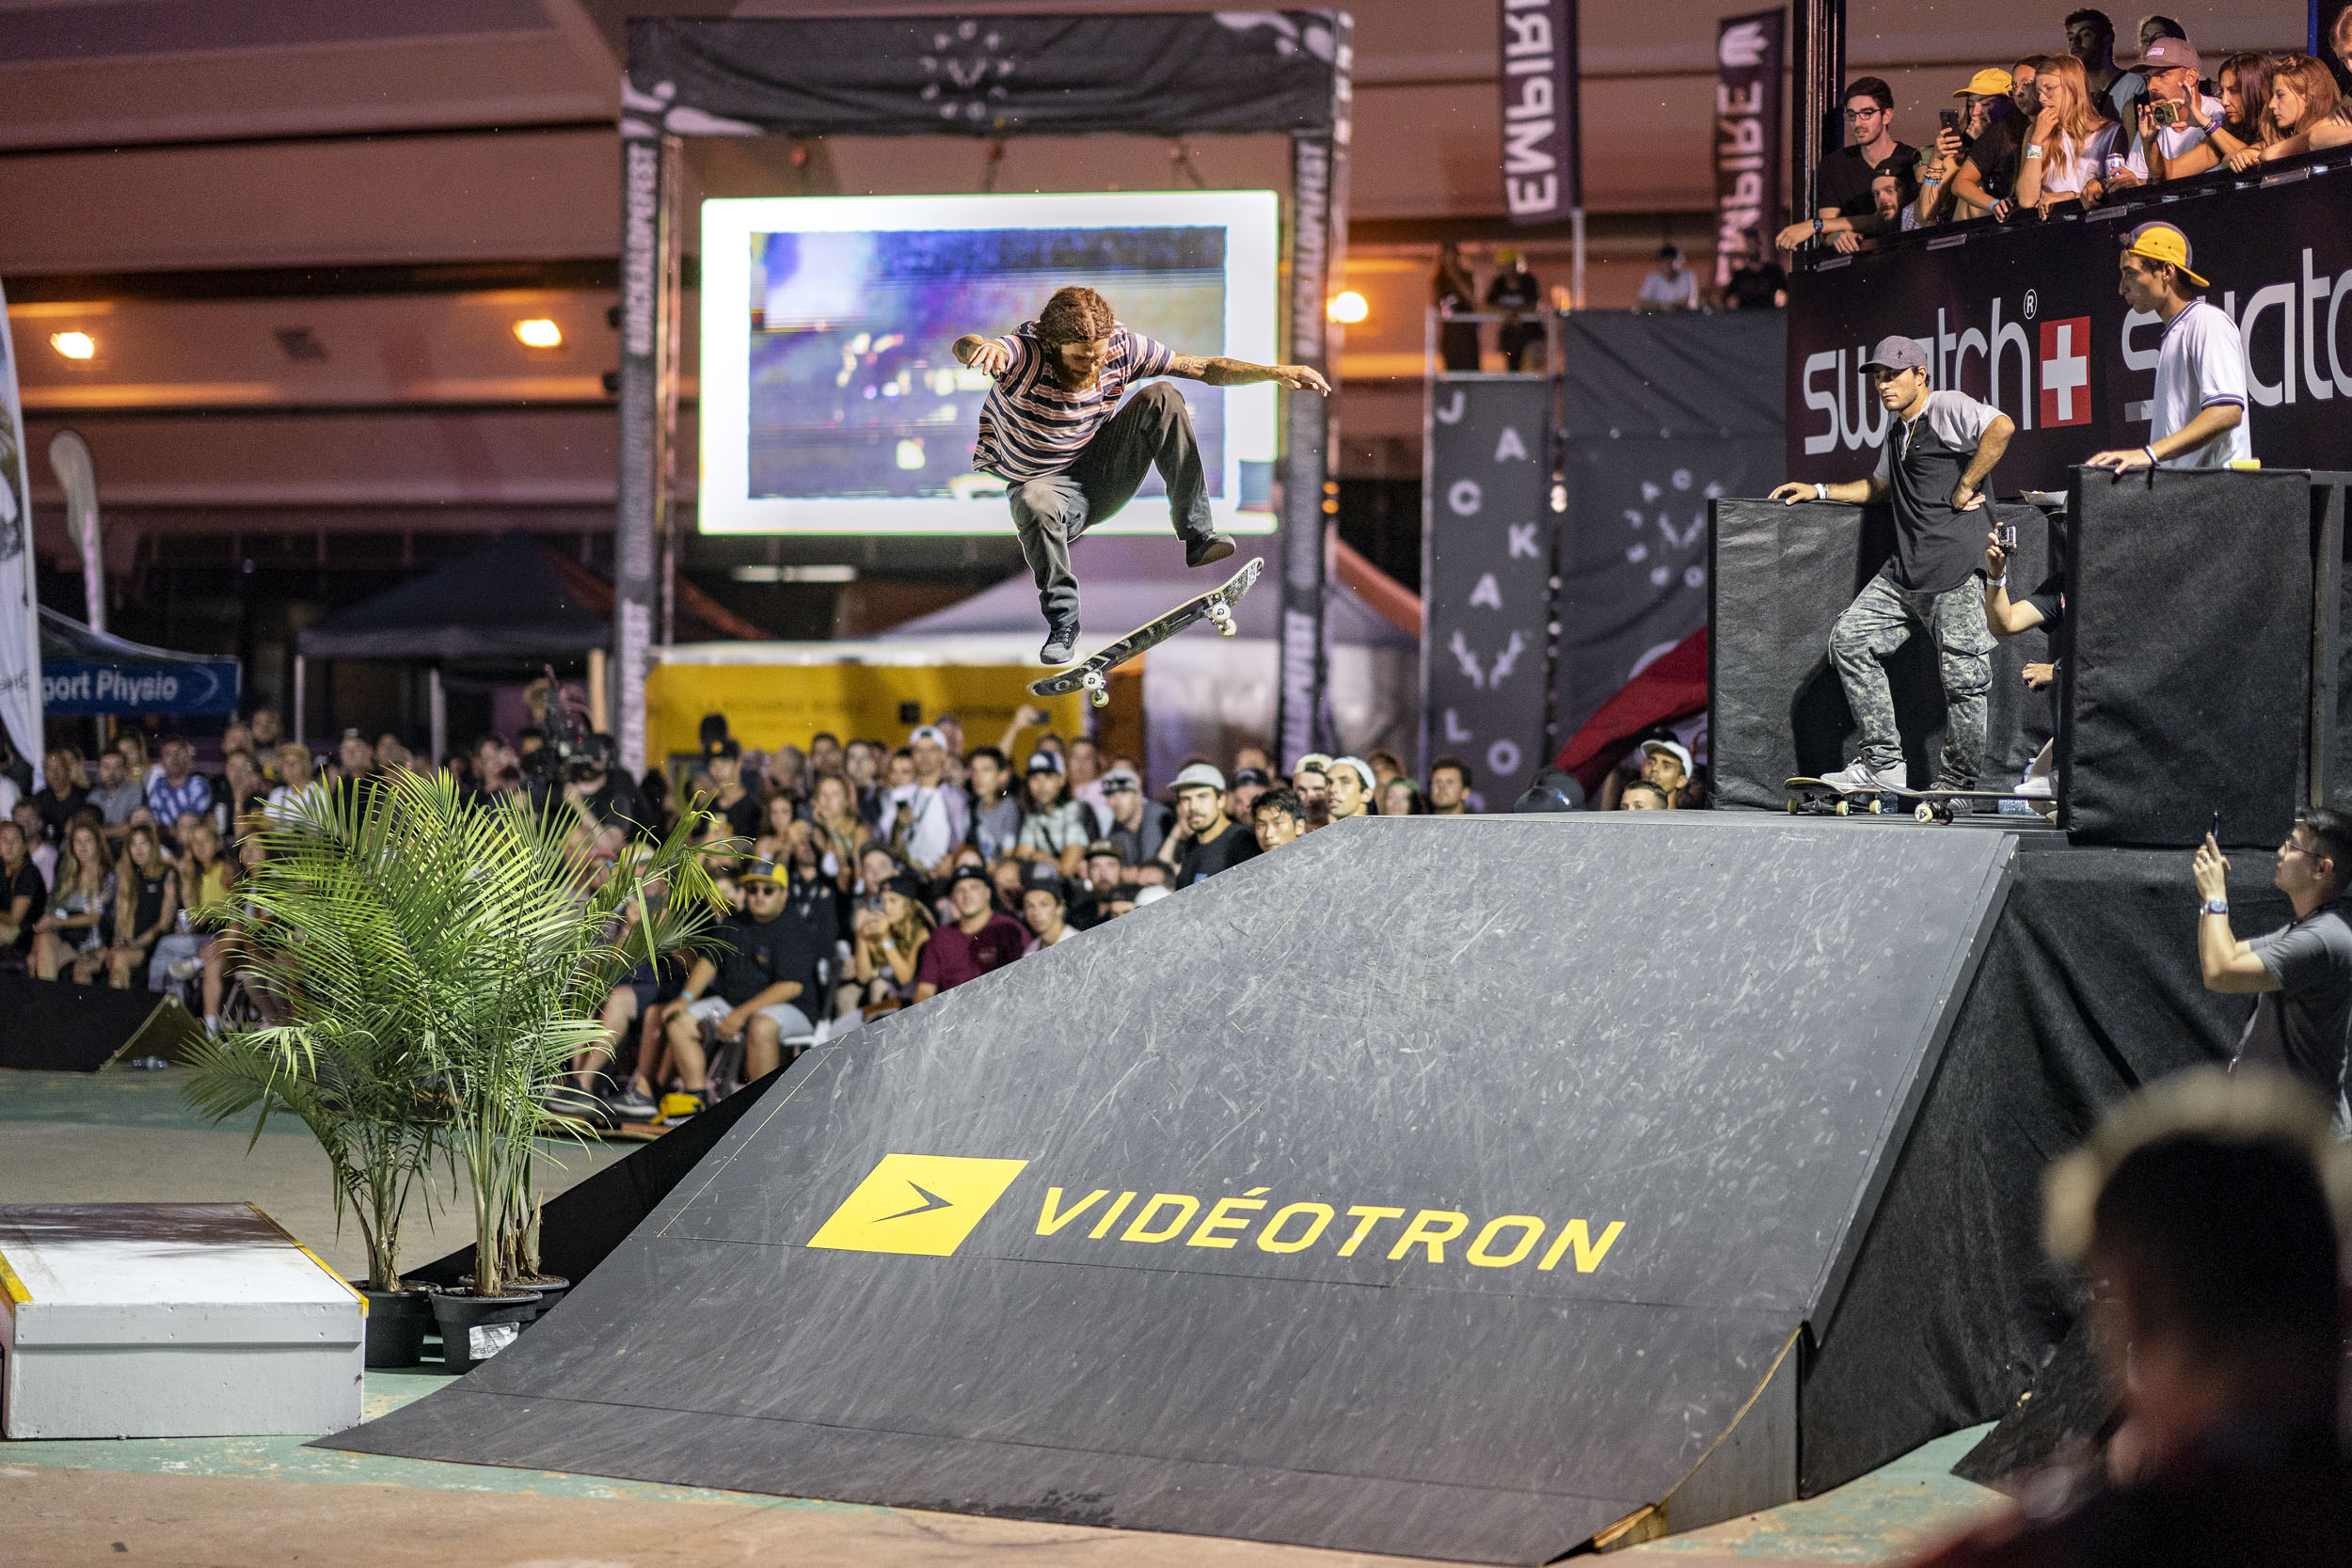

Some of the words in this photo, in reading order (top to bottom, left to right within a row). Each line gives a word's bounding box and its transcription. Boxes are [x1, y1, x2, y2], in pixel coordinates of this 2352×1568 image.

[41, 670, 90, 705] port
[96, 669, 179, 705] Physio
[1035, 1186, 1627, 1273] VIDÉOTRON
